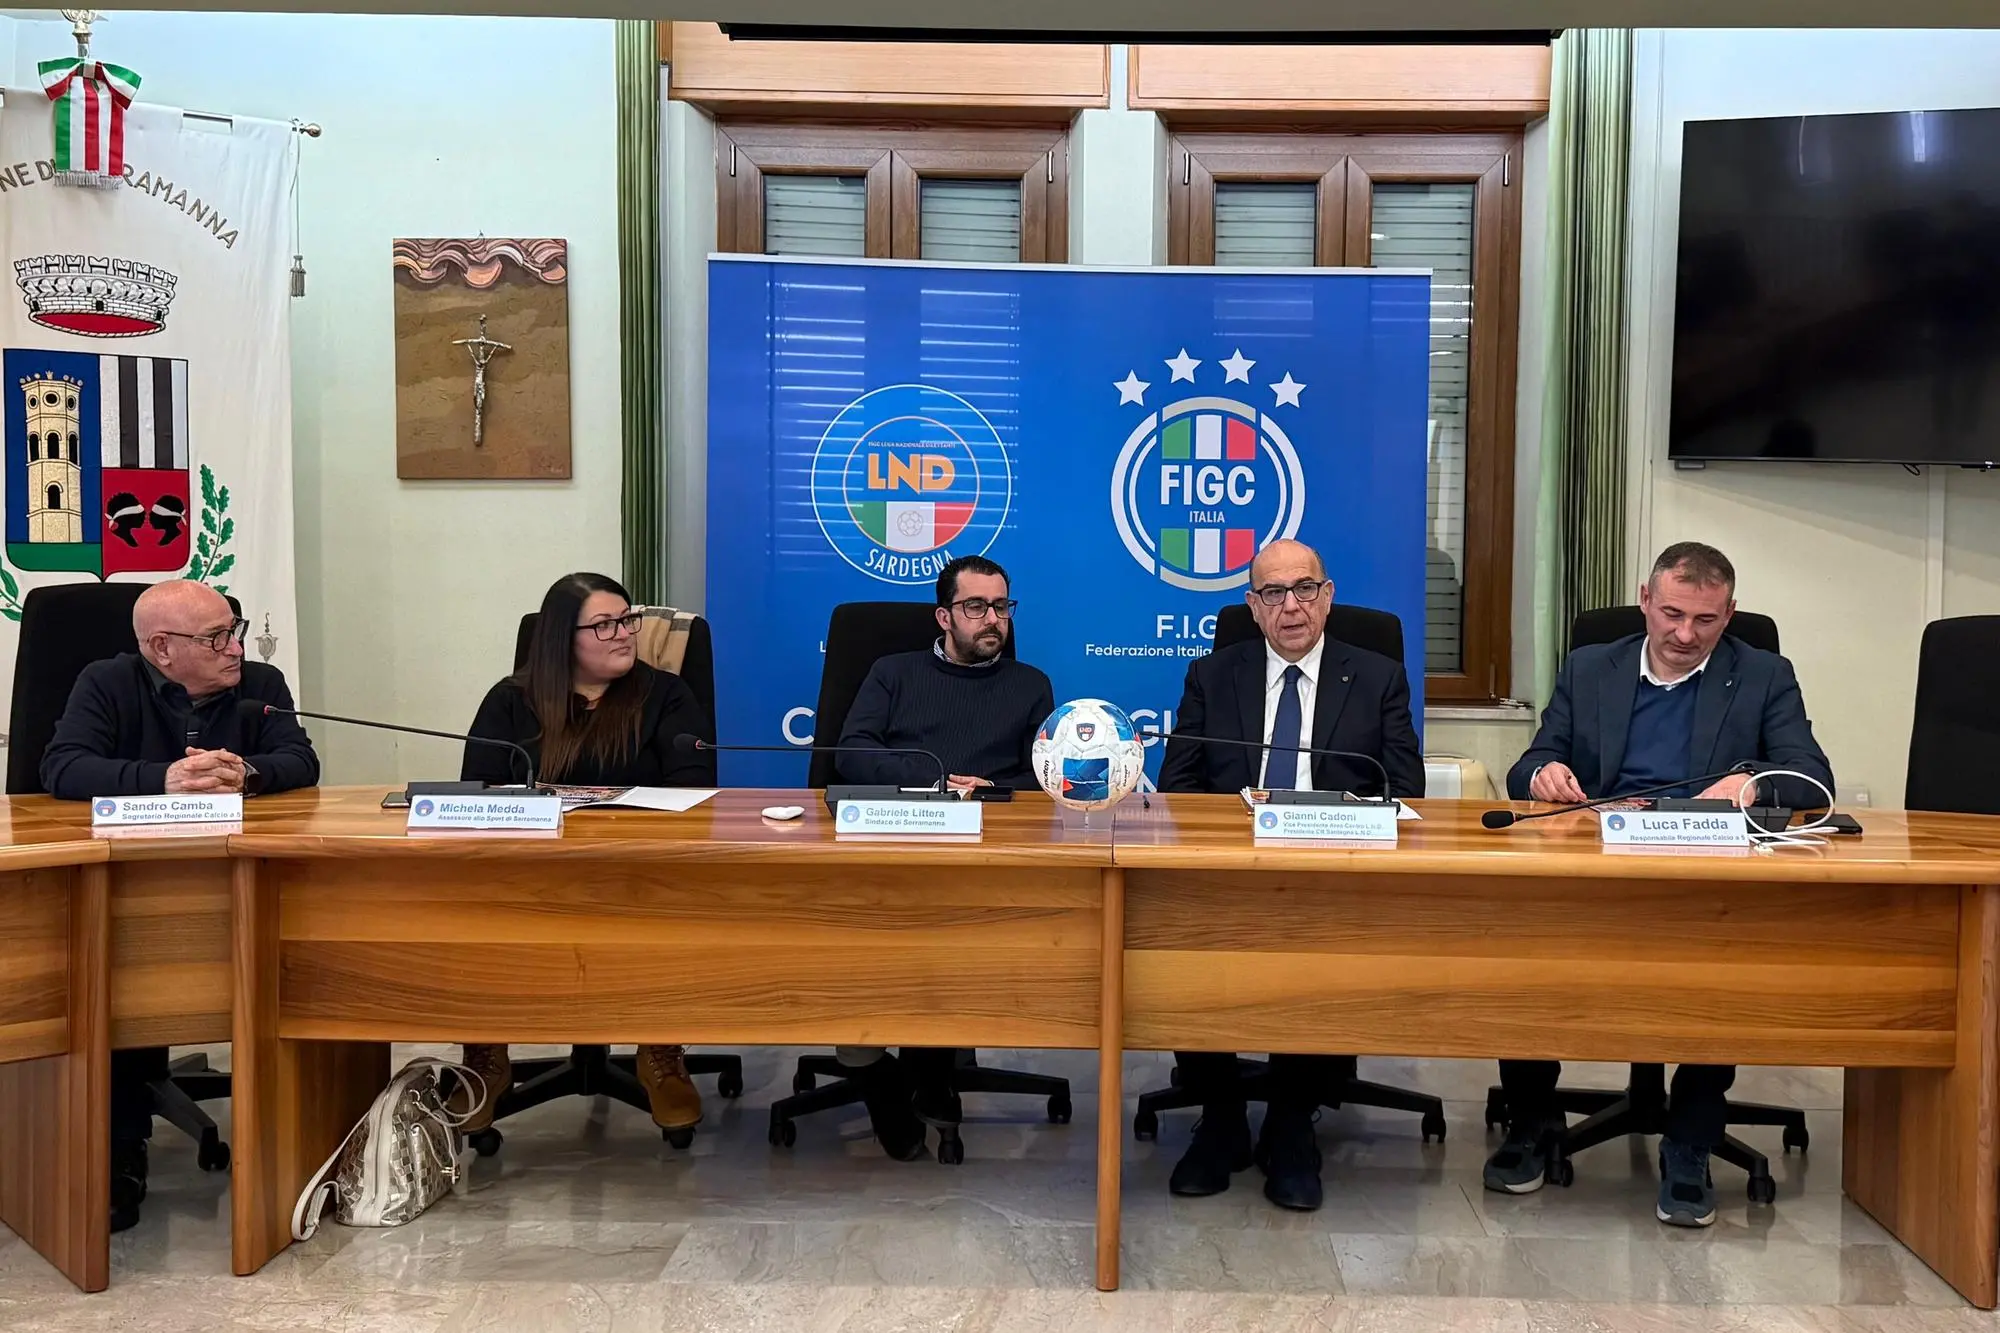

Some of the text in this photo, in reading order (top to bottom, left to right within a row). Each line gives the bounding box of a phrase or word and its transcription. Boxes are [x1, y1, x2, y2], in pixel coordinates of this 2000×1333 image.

[123, 163, 239, 249] RAMANNA
[868, 451, 955, 494] LND
[1160, 465, 1255, 505] FIGC
[1189, 511, 1225, 523] ITALIA
[865, 548, 955, 577] SARDEGNA
[1157, 614, 1218, 640] F.I.G
[1085, 643, 1213, 657] Federazione Italia
[123, 801, 213, 811] Sandro Camba
[439, 803, 525, 814] Michela Medda
[164, 812, 202, 820] Regionale
[866, 807, 945, 818] Gabriele Littera
[1283, 811, 1356, 821] Gianni Cadoni
[865, 818, 893, 826] Sindaco
[1642, 818, 1728, 830] Luca Fadda
